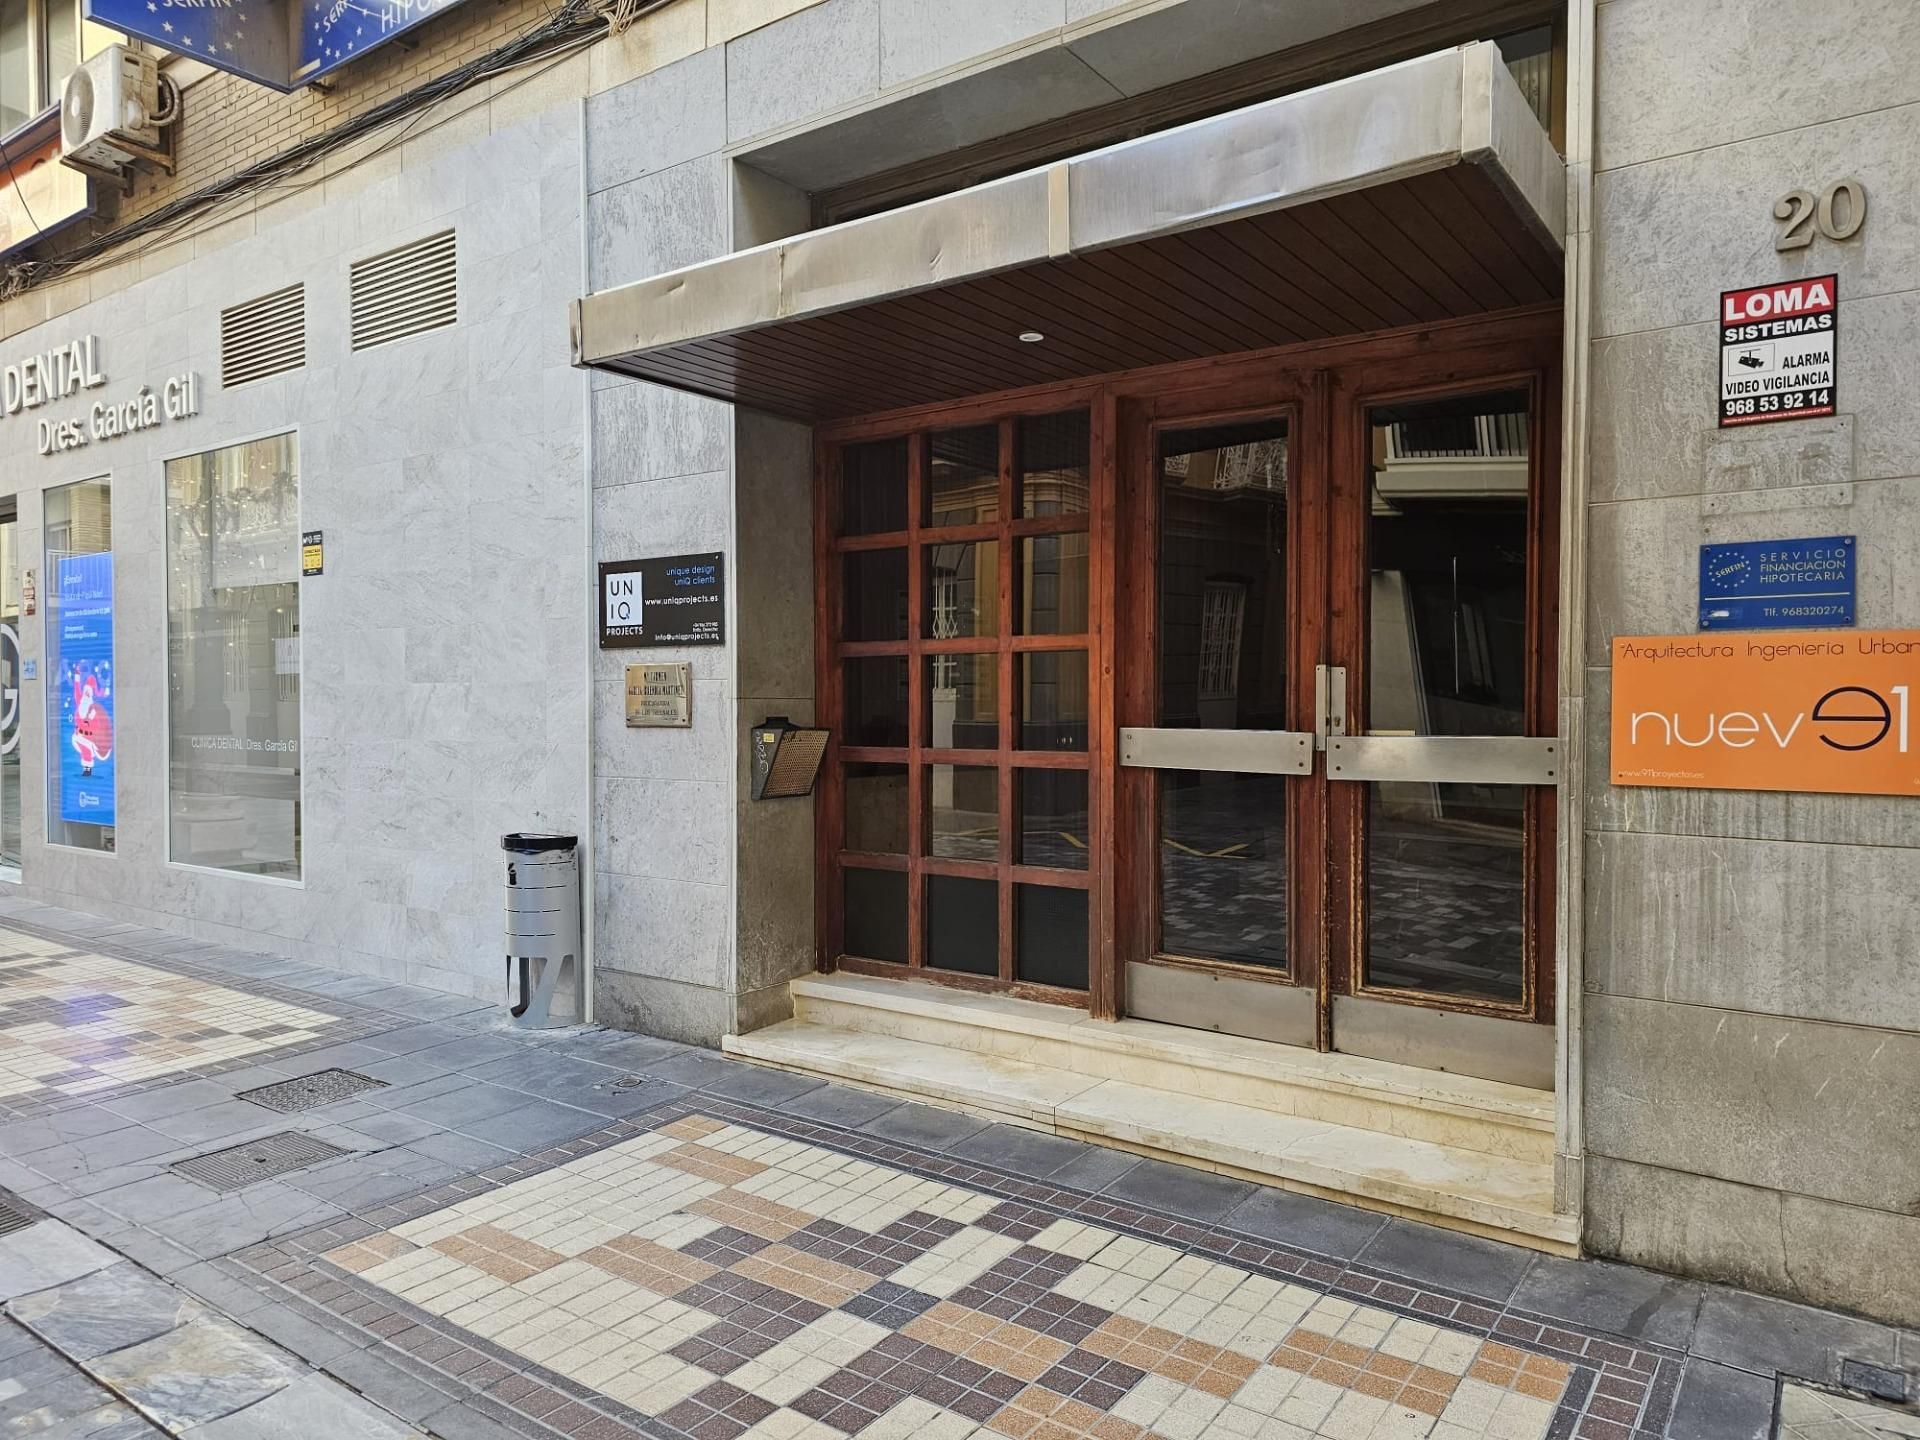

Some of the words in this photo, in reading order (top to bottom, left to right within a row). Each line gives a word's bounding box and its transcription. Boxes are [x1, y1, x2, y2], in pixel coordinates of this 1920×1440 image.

[1773, 178, 1867, 252] 20
[1725, 283, 1831, 321] LOMA
[1725, 314, 1832, 342] SISTEMAS
[1782, 351, 1830, 369] ALARMA
[4, 334, 107, 415] DENTAL
[1726, 380, 1760, 395] VIDEO
[1763, 371, 1830, 391] VIGILANCIA
[1725, 399, 1755, 416] 968
[1759, 397, 1779, 411] 53
[1783, 393, 1804, 409] 92
[1809, 389, 1829, 406] 14
[38, 418, 88, 455] Dres.
[90, 384, 161, 440] García
[164, 371, 199, 420] Gil
[1760, 549, 1846, 562] SERVICIO
[666, 567, 690, 577] unique
[691, 564, 715, 575] design
[1760, 560, 1846, 573] FINANCIACION
[692, 576, 715, 585] clients
[1760, 571, 1845, 584] HIPOTECARIA
[610, 579, 633, 596] UN
[644, 595, 718, 606] www.uniqprojects.es
[611, 601, 631, 620] IQ
[1781, 606, 1844, 617] 968320274
[606, 626, 643, 636] PROJECTS
[1623, 642, 1733, 663] Arquitectura
